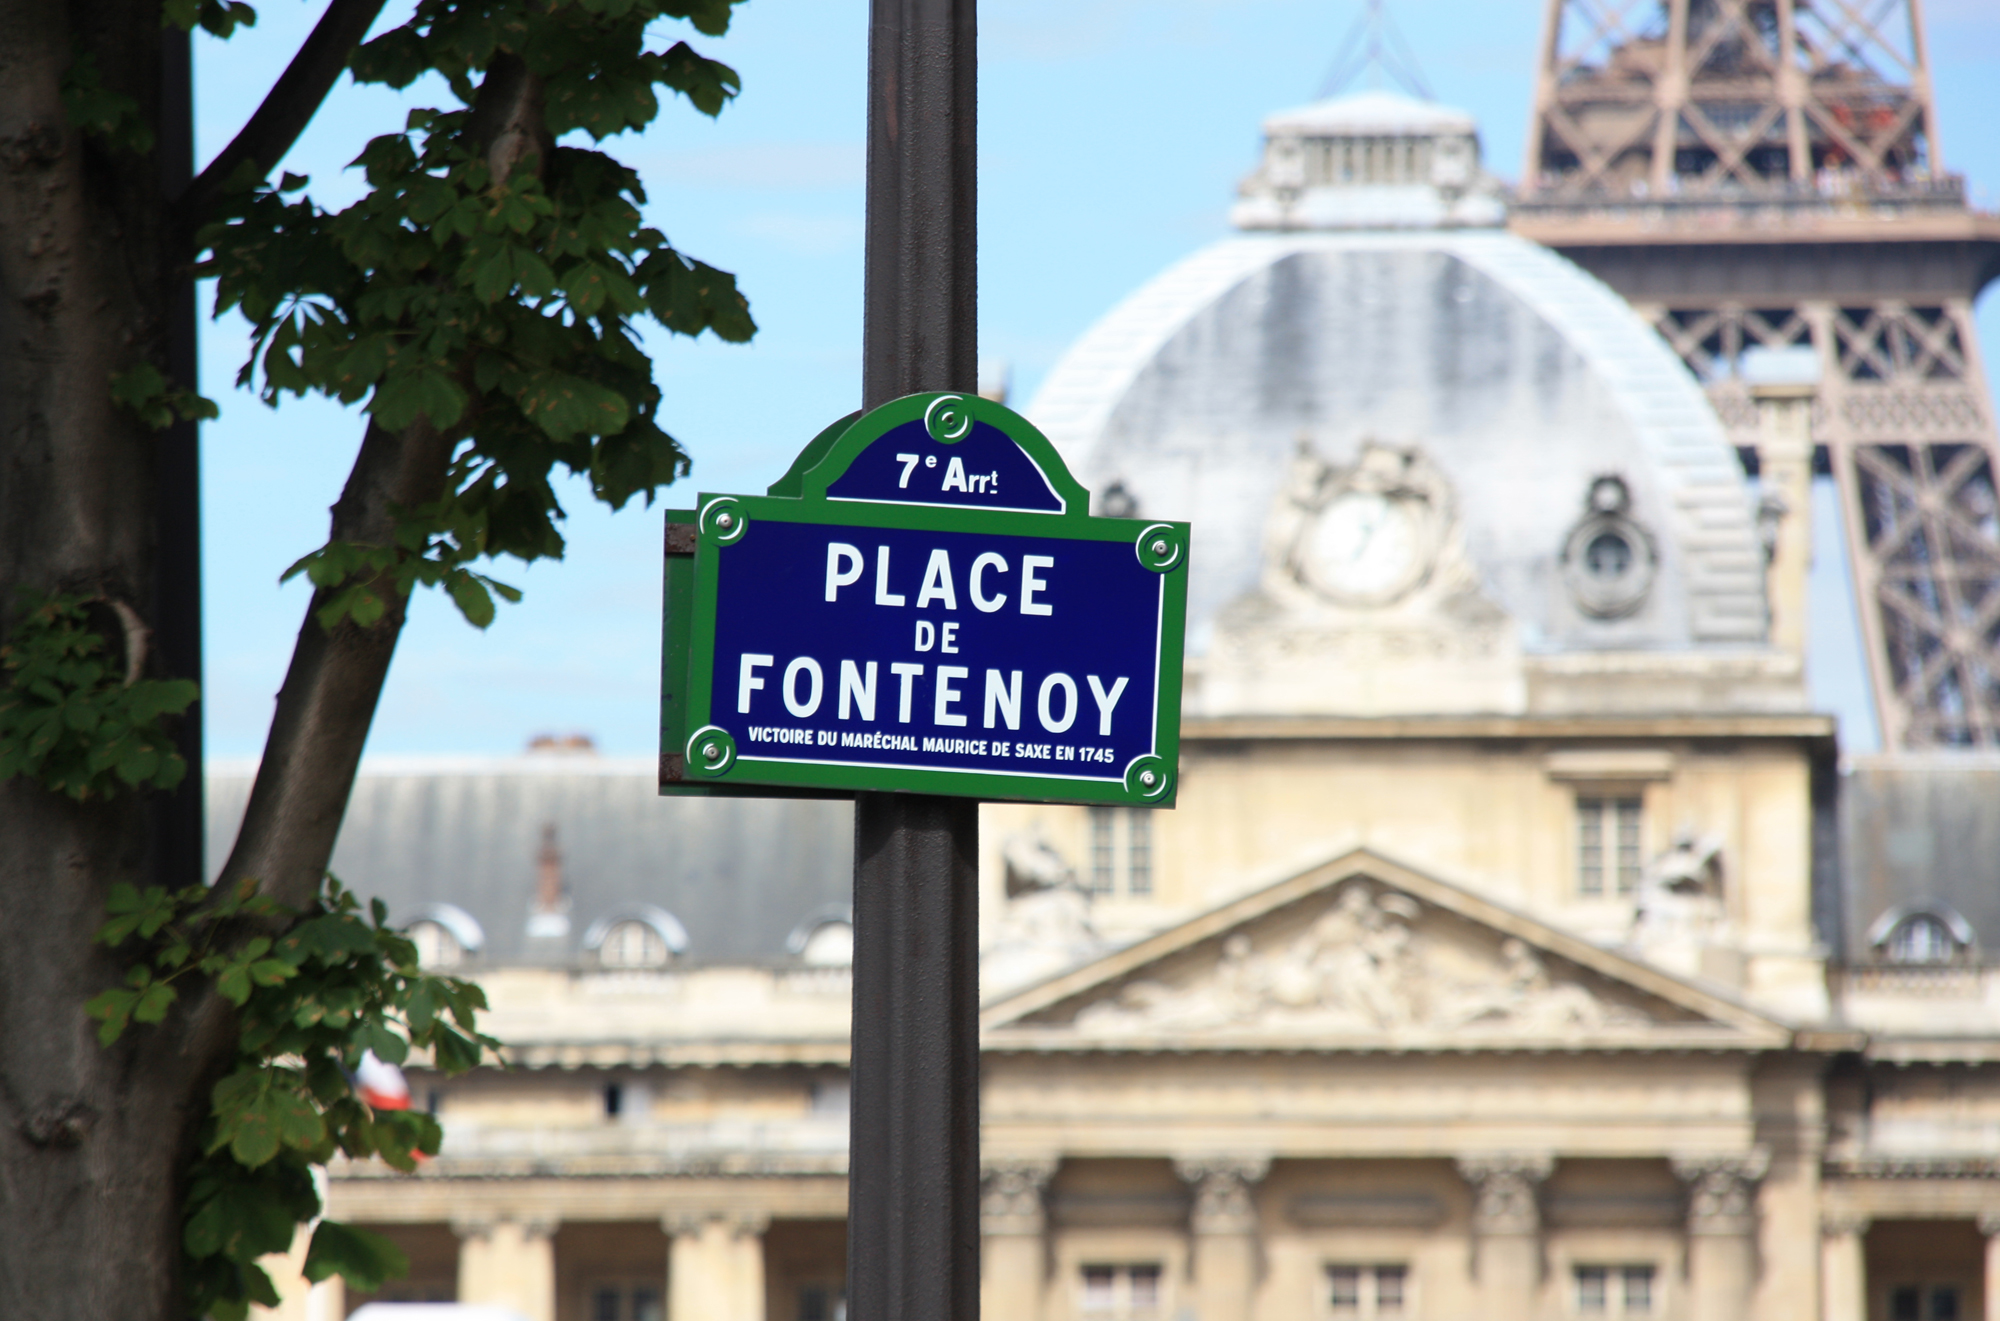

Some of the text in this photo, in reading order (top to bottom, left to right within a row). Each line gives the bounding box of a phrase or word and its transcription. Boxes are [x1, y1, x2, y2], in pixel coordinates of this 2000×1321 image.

[824, 542, 1055, 617] PLACE
[914, 620, 960, 654] DE
[737, 653, 1130, 736] FONTENOY
[748, 726, 1115, 764] VICTOIRE DU MARÉCHAL MAURICE DE SAXE EN 1745
